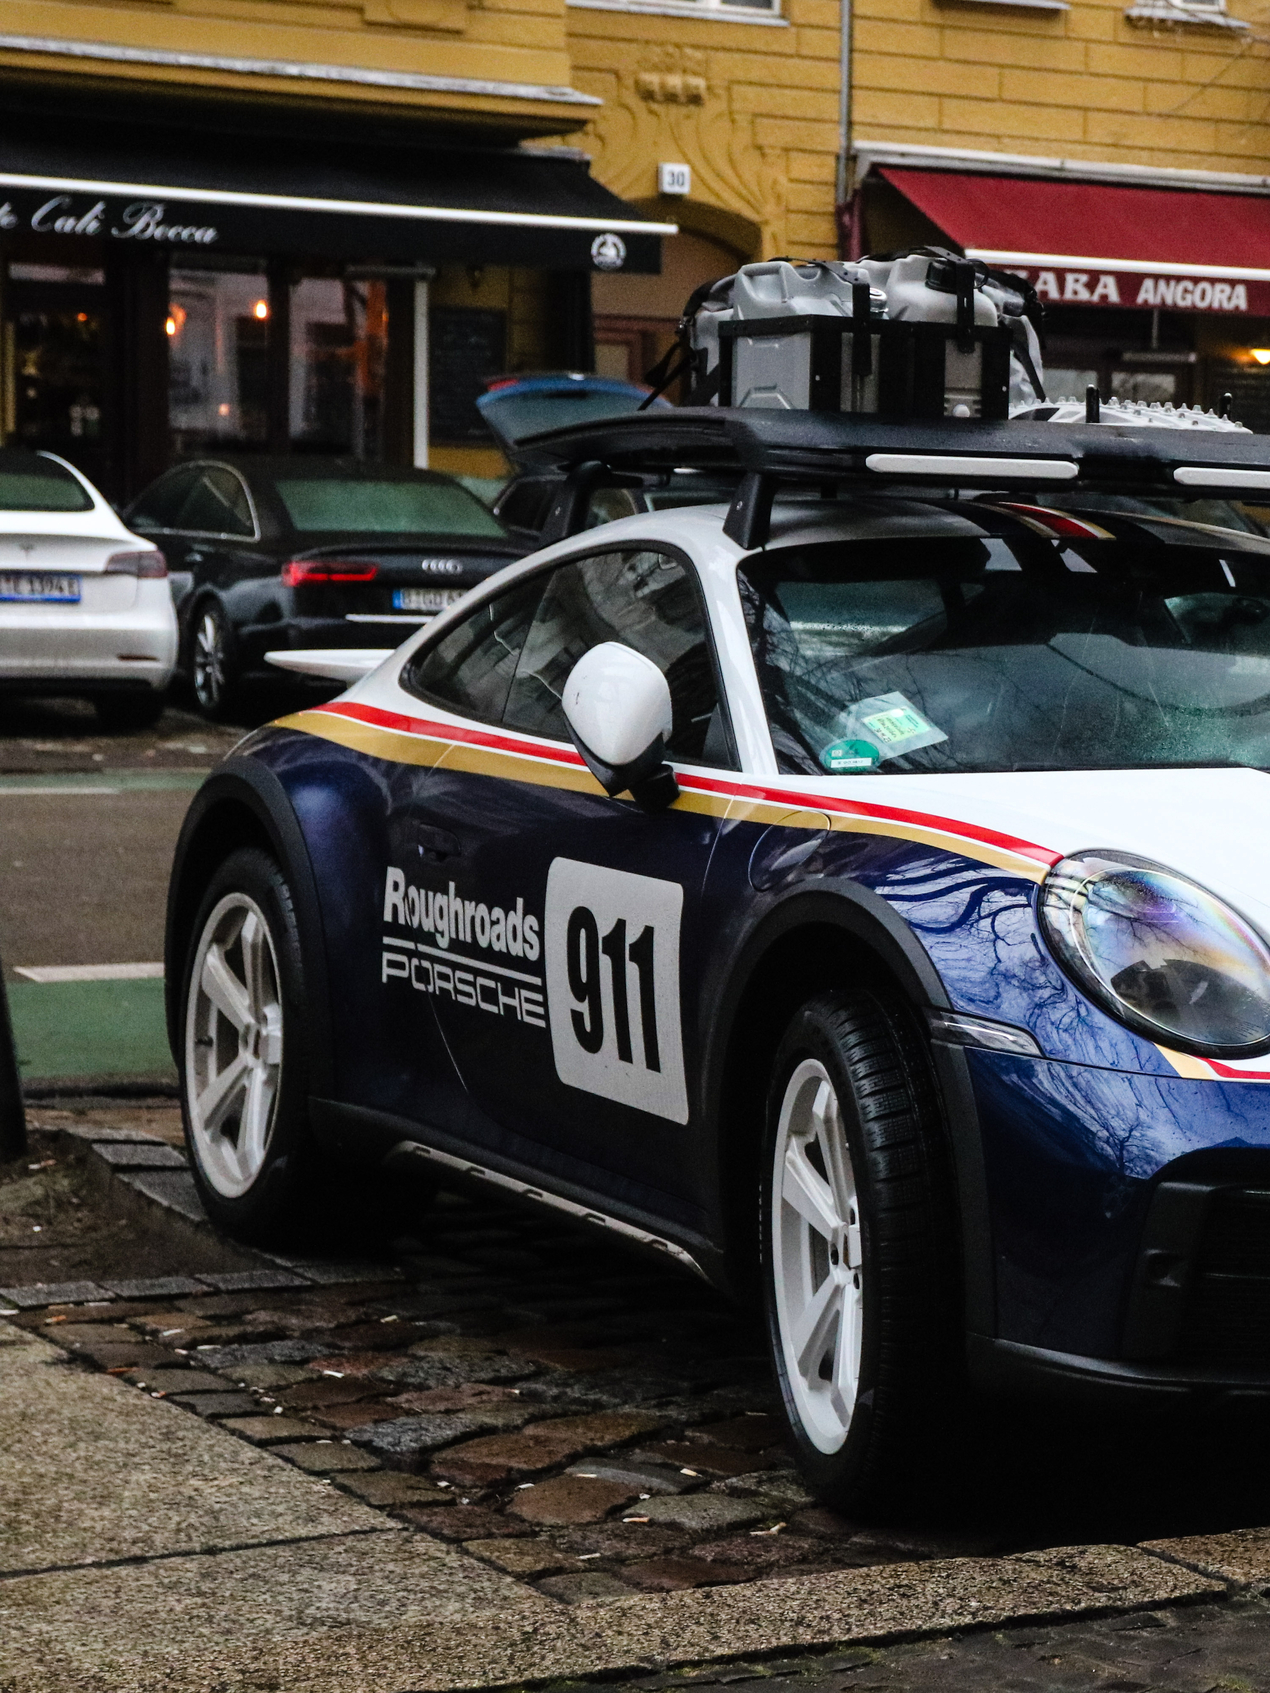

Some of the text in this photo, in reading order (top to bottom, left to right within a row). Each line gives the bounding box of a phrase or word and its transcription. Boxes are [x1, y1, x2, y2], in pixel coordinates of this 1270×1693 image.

[667, 170, 686, 188] 30
[1003, 268, 1249, 312] ABA ANGORA
[383, 865, 541, 962] Roughroads
[381, 950, 547, 1029] PORSCHE
[567, 905, 662, 1075] 911
